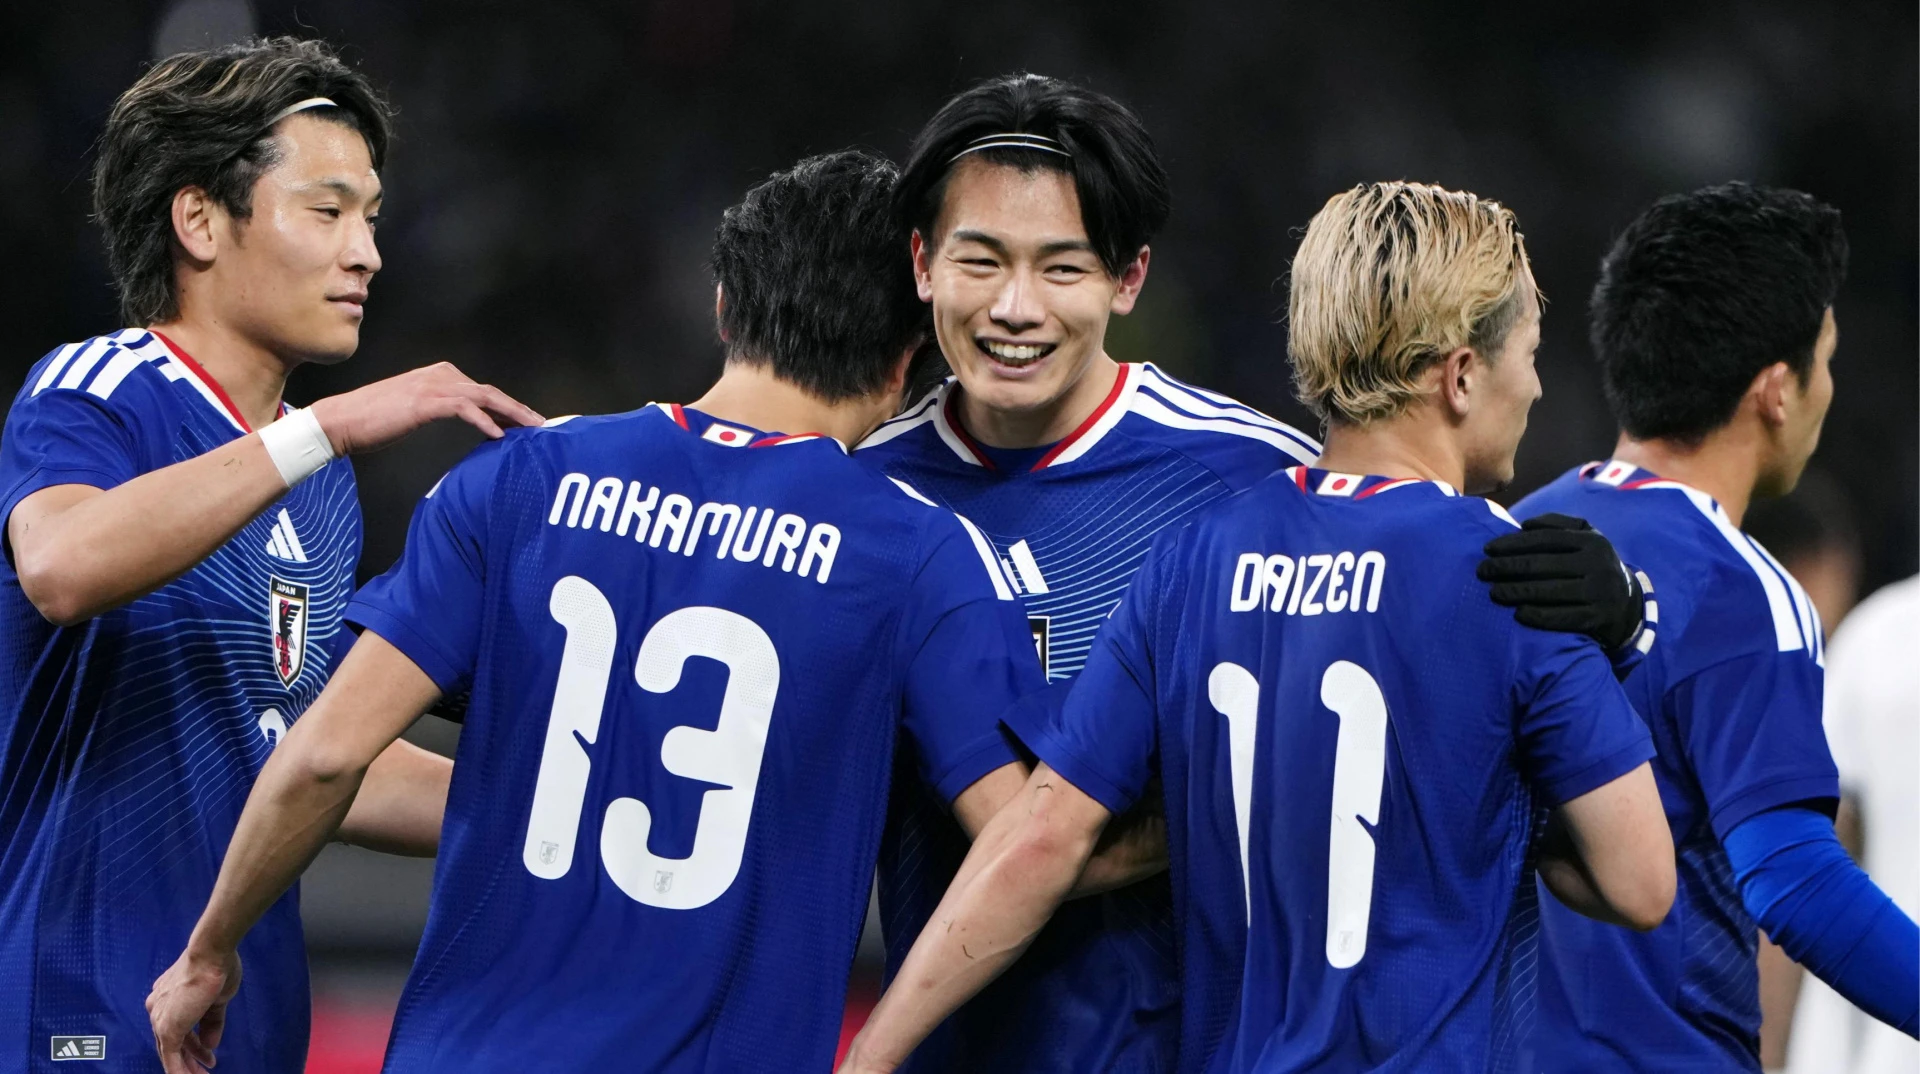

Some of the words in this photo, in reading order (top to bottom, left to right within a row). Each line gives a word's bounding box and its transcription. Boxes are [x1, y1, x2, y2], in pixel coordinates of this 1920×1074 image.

[549, 473, 841, 583] NAKAMURA
[276, 582, 296, 596] JAPAN
[1231, 551, 1385, 616] DAIZEN
[523, 576, 780, 909] 13
[1208, 661, 1387, 968] 11
